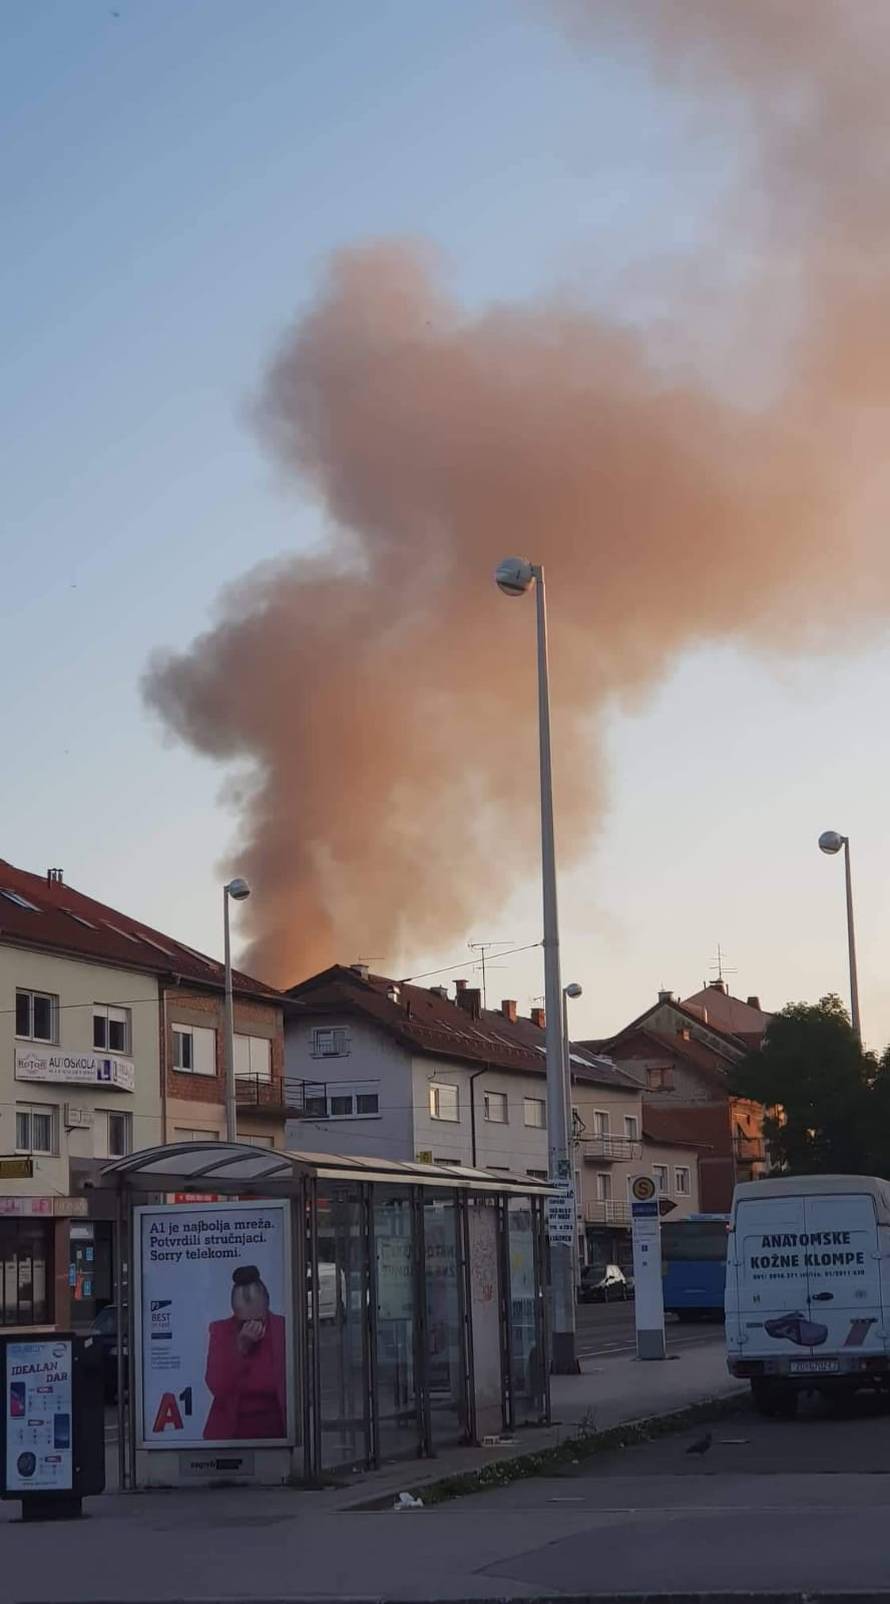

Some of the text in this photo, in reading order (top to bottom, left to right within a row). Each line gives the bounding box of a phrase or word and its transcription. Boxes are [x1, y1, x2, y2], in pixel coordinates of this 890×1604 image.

[639, 1181, 649, 1196] S
[149, 1218, 275, 1235] A1 je najbolja mreža.
[150, 1232, 267, 1247] Potvrdili stručnjaci.
[761, 1231, 851, 1248] ANATOMSKE
[150, 1247, 241, 1262] Sorry telekomi.
[751, 1252, 864, 1269] KOŽNE KLOMPE
[152, 1313, 171, 1321] BEST
[11, 1361, 58, 1376] IDEALAN
[46, 1372, 68, 1383] DAR
[152, 1386, 192, 1432] A1
